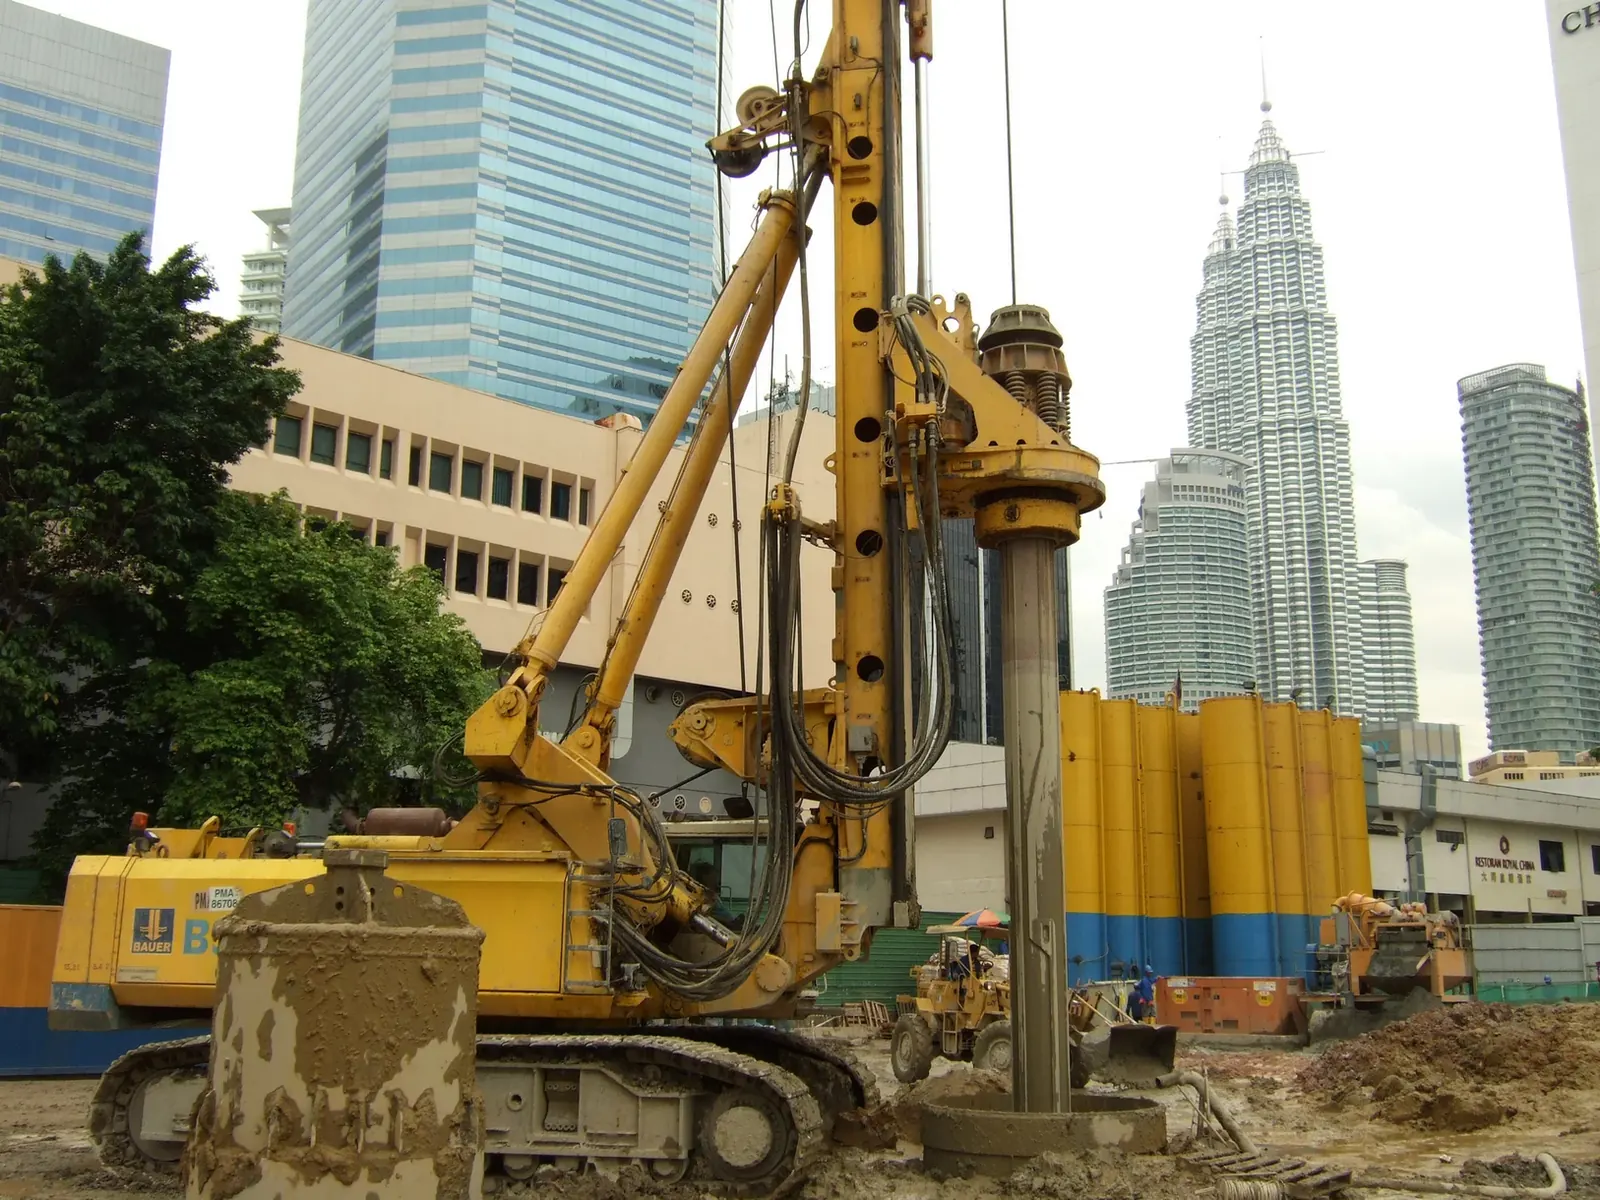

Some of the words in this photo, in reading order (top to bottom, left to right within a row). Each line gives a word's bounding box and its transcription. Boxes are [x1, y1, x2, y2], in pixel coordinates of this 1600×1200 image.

[1475, 856, 1502, 868] RESTORAN
[1502, 859, 1519, 870] ROYAL
[1519, 860, 1536, 871] CHINA
[214, 889, 234, 897] PMA
[195, 892, 209, 909] PM
[211, 899, 238, 909] 86708
[133, 942, 171, 953] BAUER
